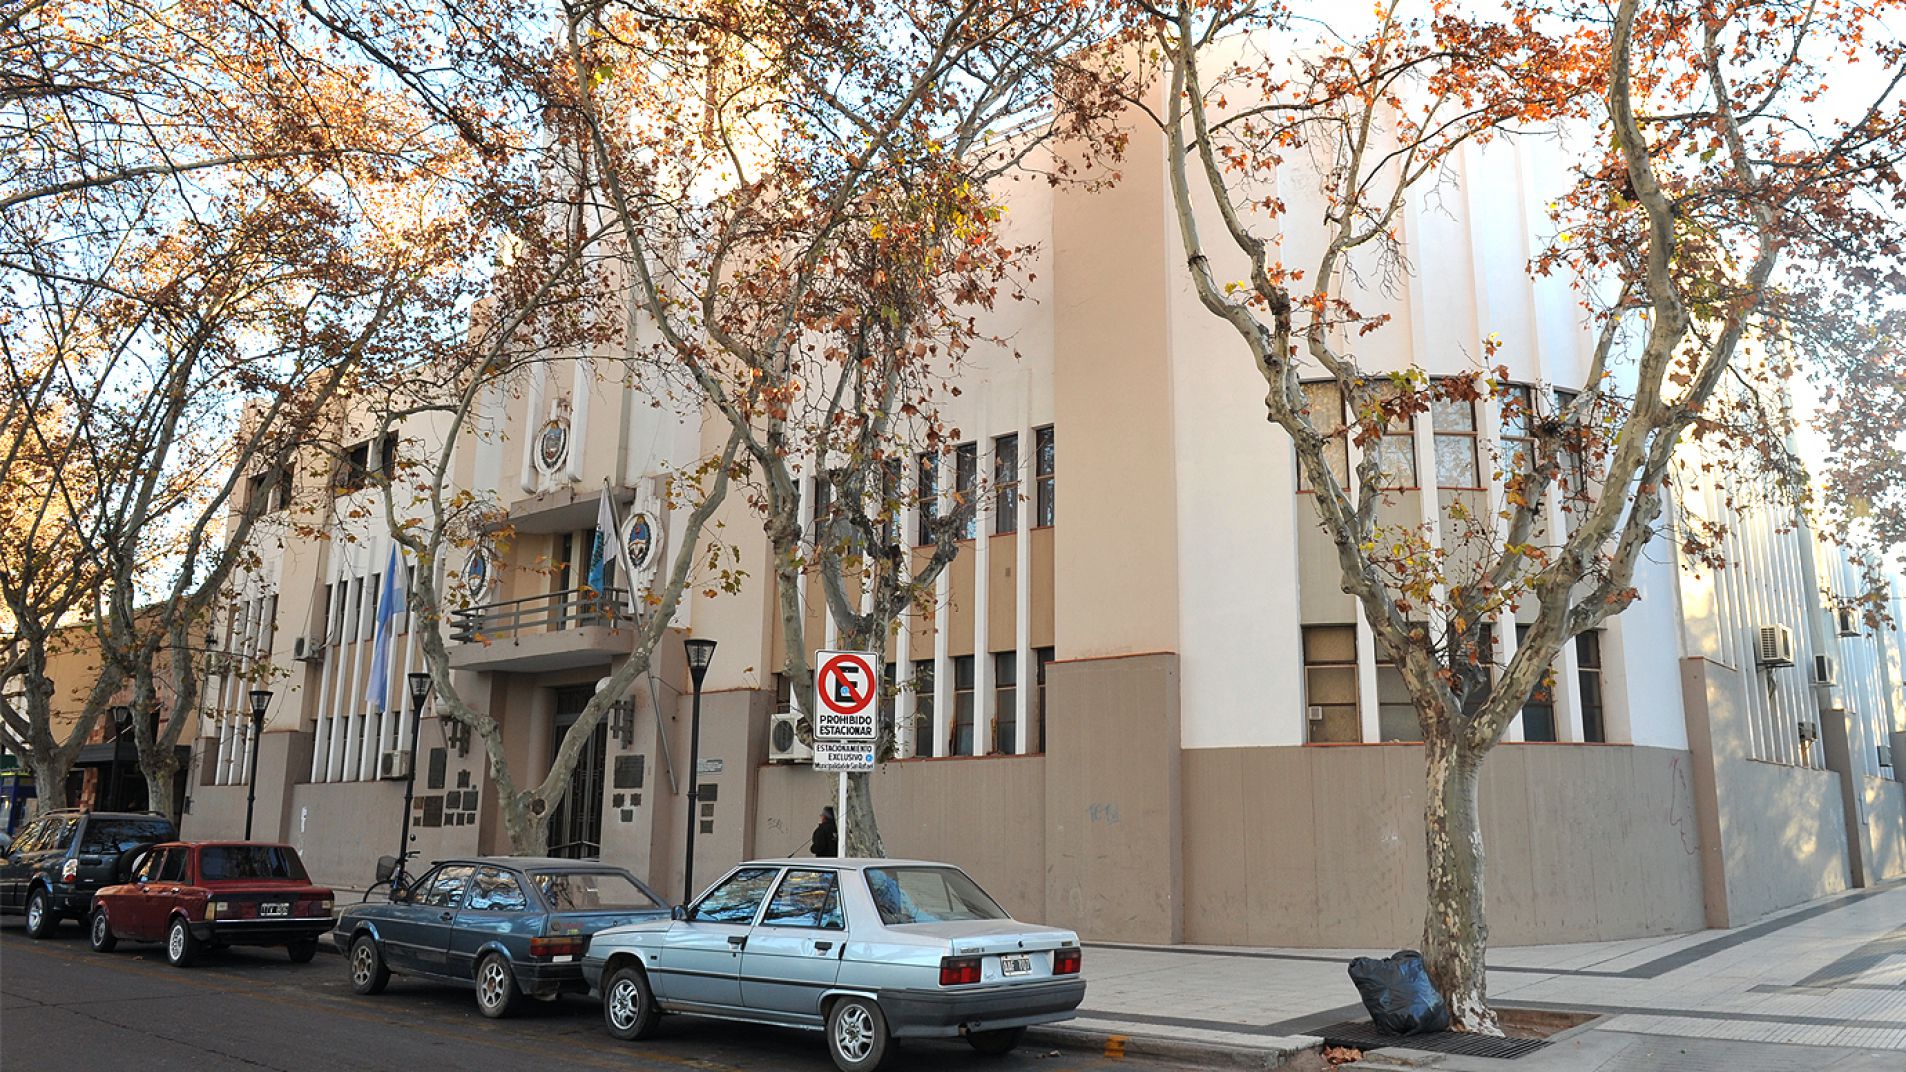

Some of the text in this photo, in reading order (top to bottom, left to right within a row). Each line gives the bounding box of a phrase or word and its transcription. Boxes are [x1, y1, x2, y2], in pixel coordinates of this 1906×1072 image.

[820, 715, 872, 725] PROHIBIDO
[820, 726, 872, 736] ESTACIONAR
[816, 744, 872, 753] ESTACIONAMIENTO
[828, 753, 863, 761] EXCLUSIVO
